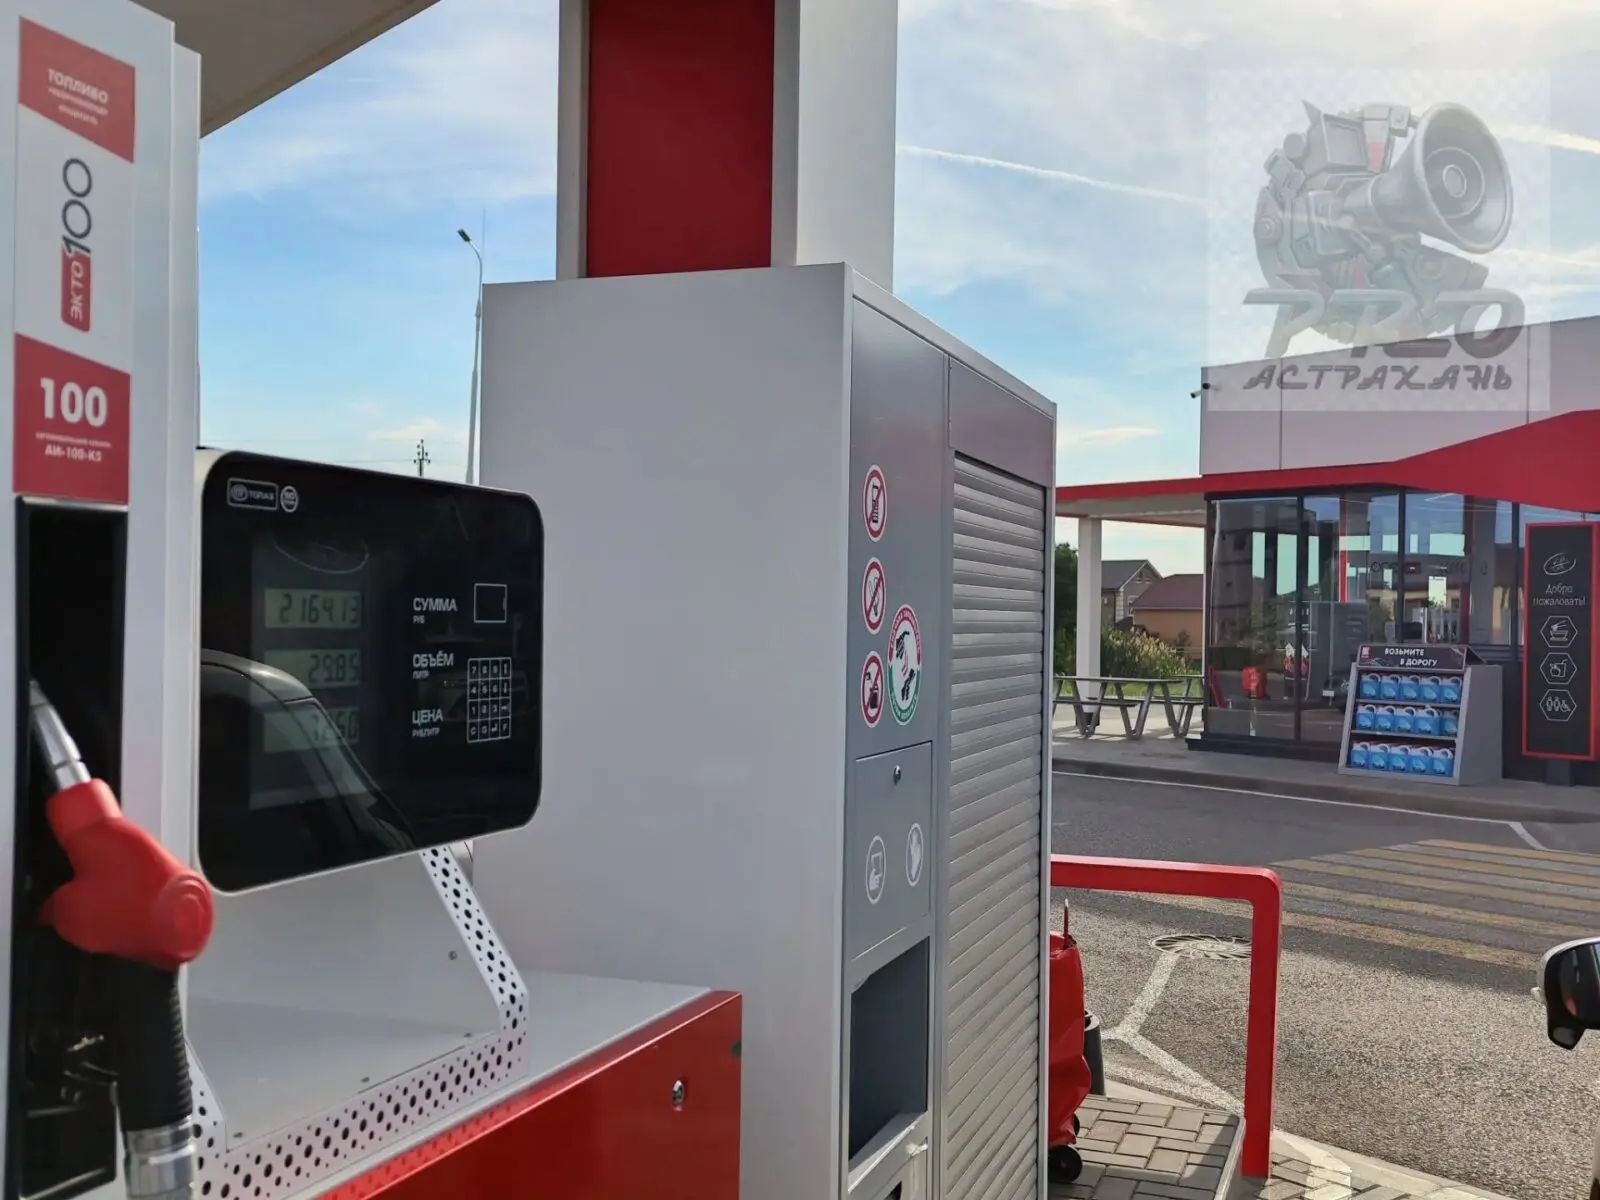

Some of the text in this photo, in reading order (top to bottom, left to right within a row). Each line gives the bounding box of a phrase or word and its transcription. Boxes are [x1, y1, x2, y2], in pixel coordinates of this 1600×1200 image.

[48, 68, 109, 105] ТОПЛИВО
[62, 158, 92, 322] ЭКТО 100
[40, 377, 108, 428] 100
[1545, 582, 1573, 596] Добро
[412, 597, 458, 612] СУММА
[412, 650, 455, 668] ОБЪЁМ
[1384, 647, 1425, 656] ВОЗЬМИТЕ
[1405, 658, 1438, 667] ДОРОГУ
[412, 708, 443, 727] ЦЕНА
